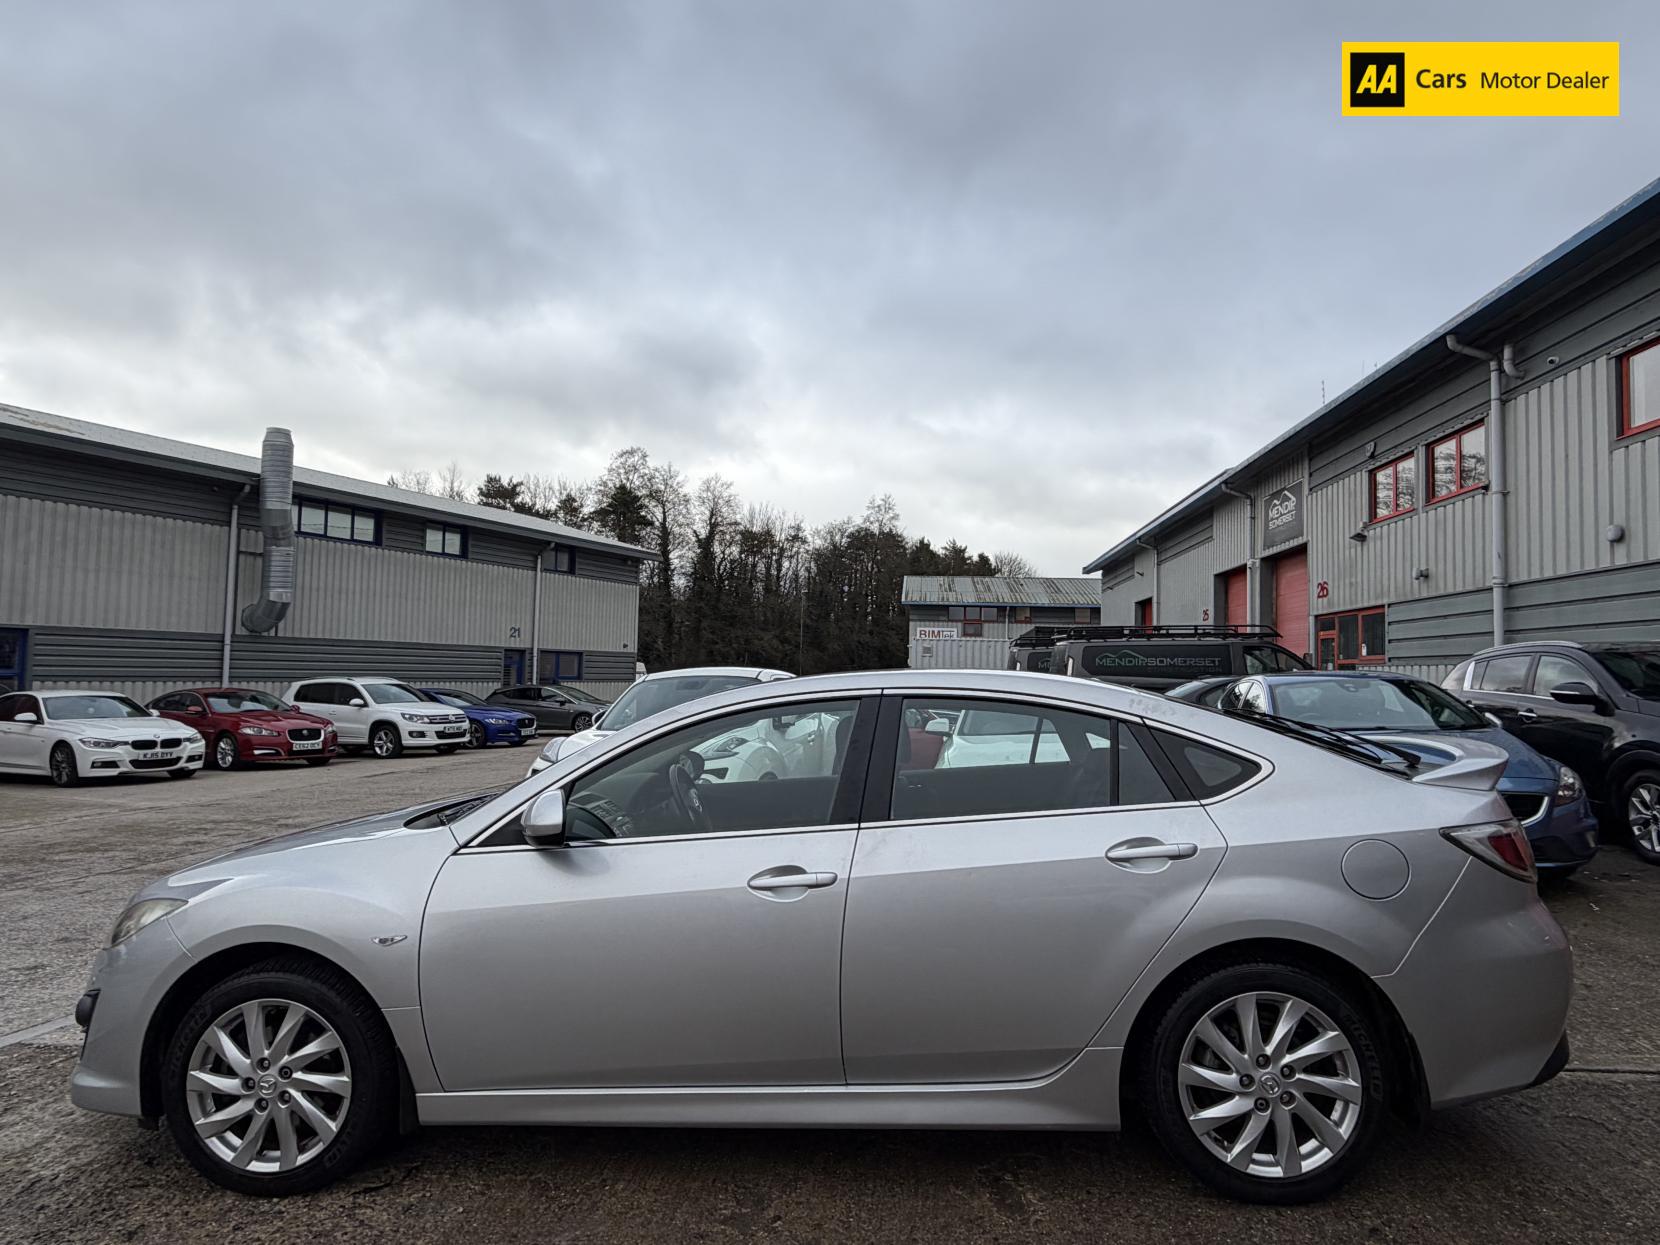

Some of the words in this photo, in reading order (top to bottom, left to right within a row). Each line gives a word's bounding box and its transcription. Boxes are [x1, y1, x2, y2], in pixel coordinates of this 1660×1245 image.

[1269, 511, 1297, 530] SOMERSET
[1317, 581, 1329, 599] 26
[1202, 609, 1210, 622] 25
[509, 626, 521, 639] 21
